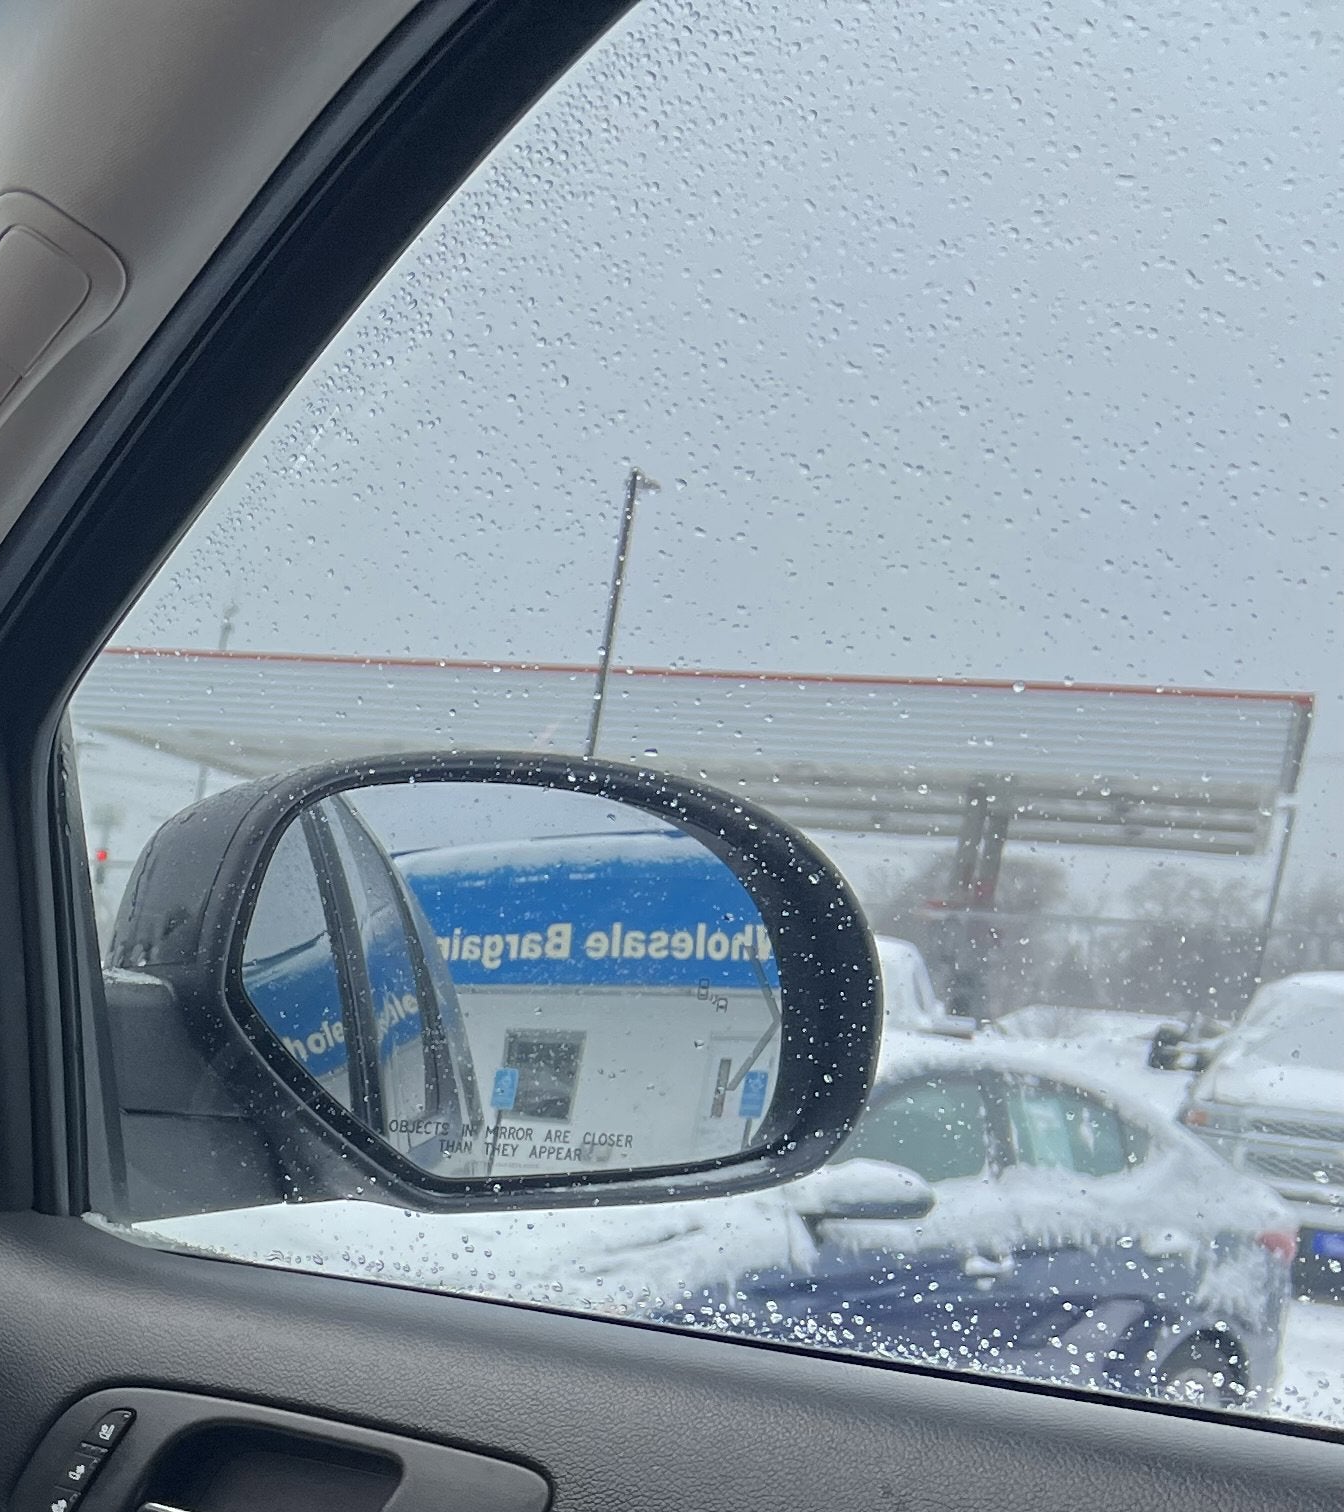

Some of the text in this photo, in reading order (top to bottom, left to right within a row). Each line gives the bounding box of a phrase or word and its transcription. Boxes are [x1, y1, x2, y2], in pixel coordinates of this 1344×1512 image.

[389, 1119, 633, 1149] OBJECTS IN MIRROR ARE CLOSER
[439, 1138, 582, 1162] THAN THEY APPEAR
